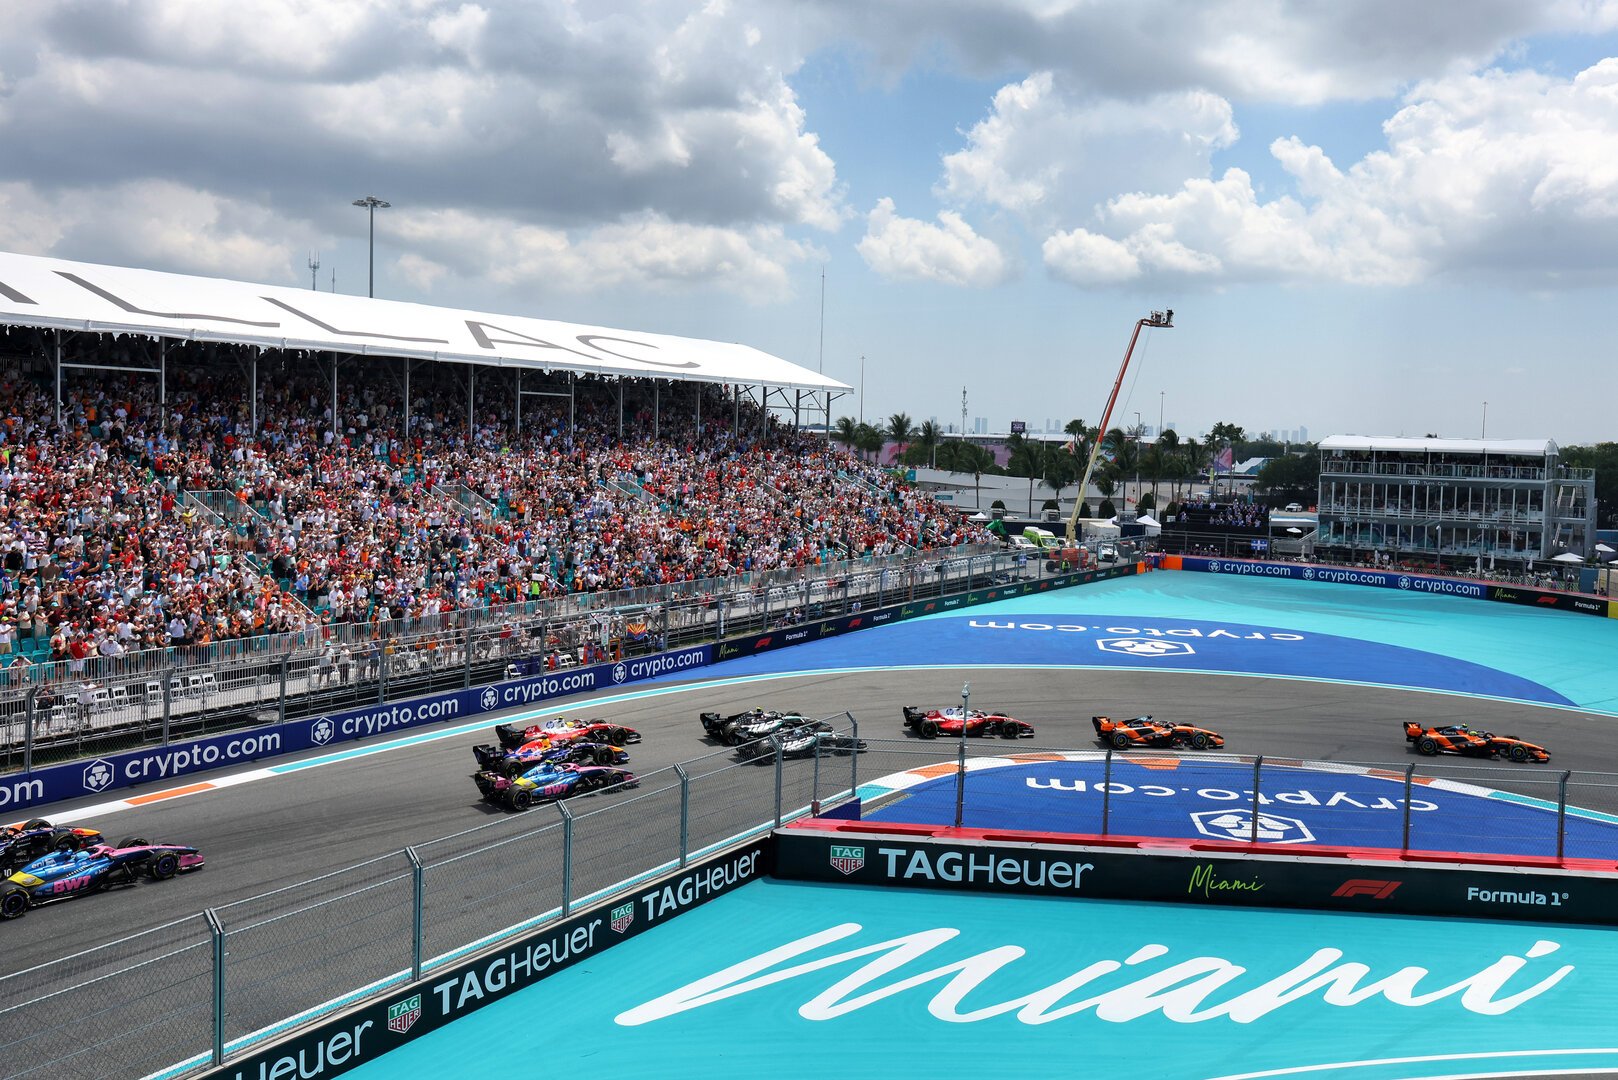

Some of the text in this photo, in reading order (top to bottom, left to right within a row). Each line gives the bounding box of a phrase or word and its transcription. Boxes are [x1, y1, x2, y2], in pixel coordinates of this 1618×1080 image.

[1224, 561, 1291, 577] crypto.com
[1318, 567, 1386, 585] crypto.com
[1414, 577, 1480, 596] crypto.com
[1574, 601, 1595, 610] Formula
[785, 631, 803, 641] Formula
[969, 620, 1304, 641] crypto.com
[630, 650, 703, 676] crypto.com
[504, 672, 594, 702] crypto.com
[342, 699, 459, 735] crypto.com
[125, 731, 280, 777] crypto.com
[544, 783, 569, 795] BWT
[1026, 777, 1439, 811] crypto.com
[833, 847, 862, 857] TAG
[832, 858, 863, 873] HEUER
[878, 848, 1094, 889] TAGHeuer
[53, 875, 91, 894] BWT
[642, 850, 761, 921] TAGHeuer
[1188, 863, 1265, 898] Miami
[1467, 887, 1547, 905] Formula
[613, 904, 632, 918] TAG
[612, 914, 634, 931] HEUER
[433, 918, 602, 1015] TAGHeuer
[615, 923, 1575, 1026] Miami
[391, 997, 419, 1016] TAG
[389, 1008, 420, 1031] HEUER
